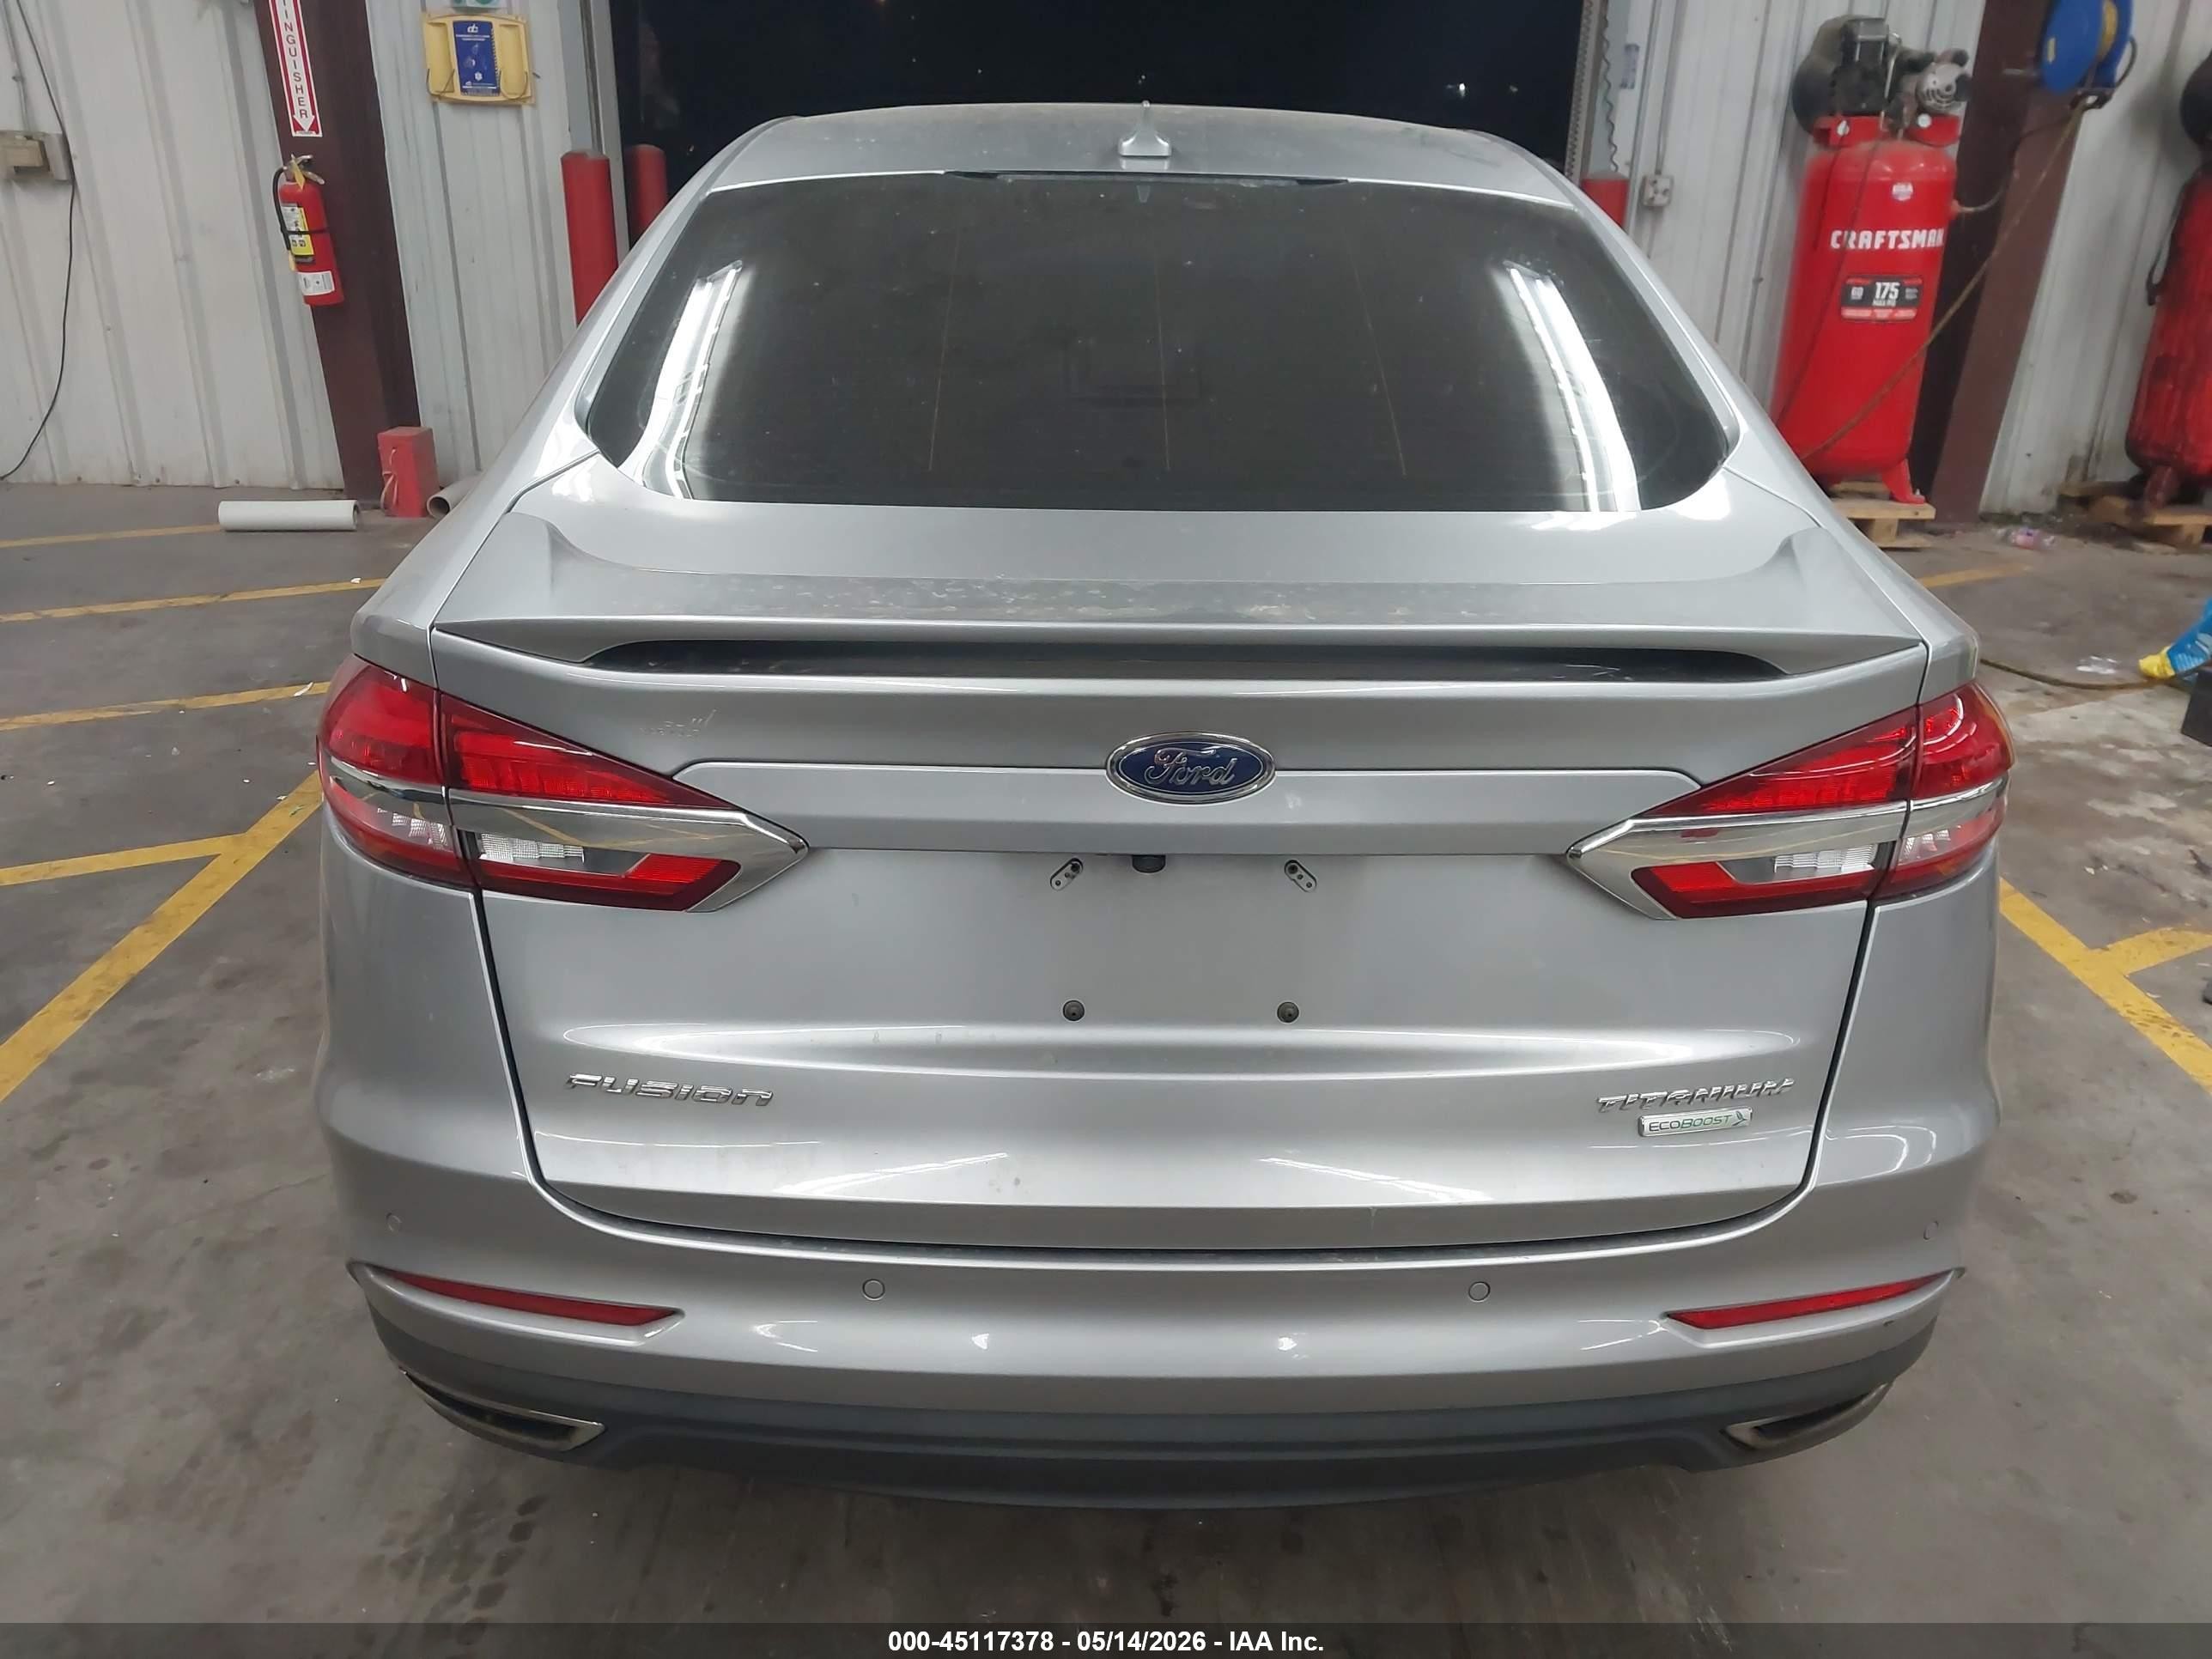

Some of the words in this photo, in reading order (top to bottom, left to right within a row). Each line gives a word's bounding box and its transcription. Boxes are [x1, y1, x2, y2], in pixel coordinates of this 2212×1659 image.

[1875, 282, 1900, 300] 175
[1144, 747, 1238, 786] Ford
[1597, 1078, 1795, 1114] TITANIUM
